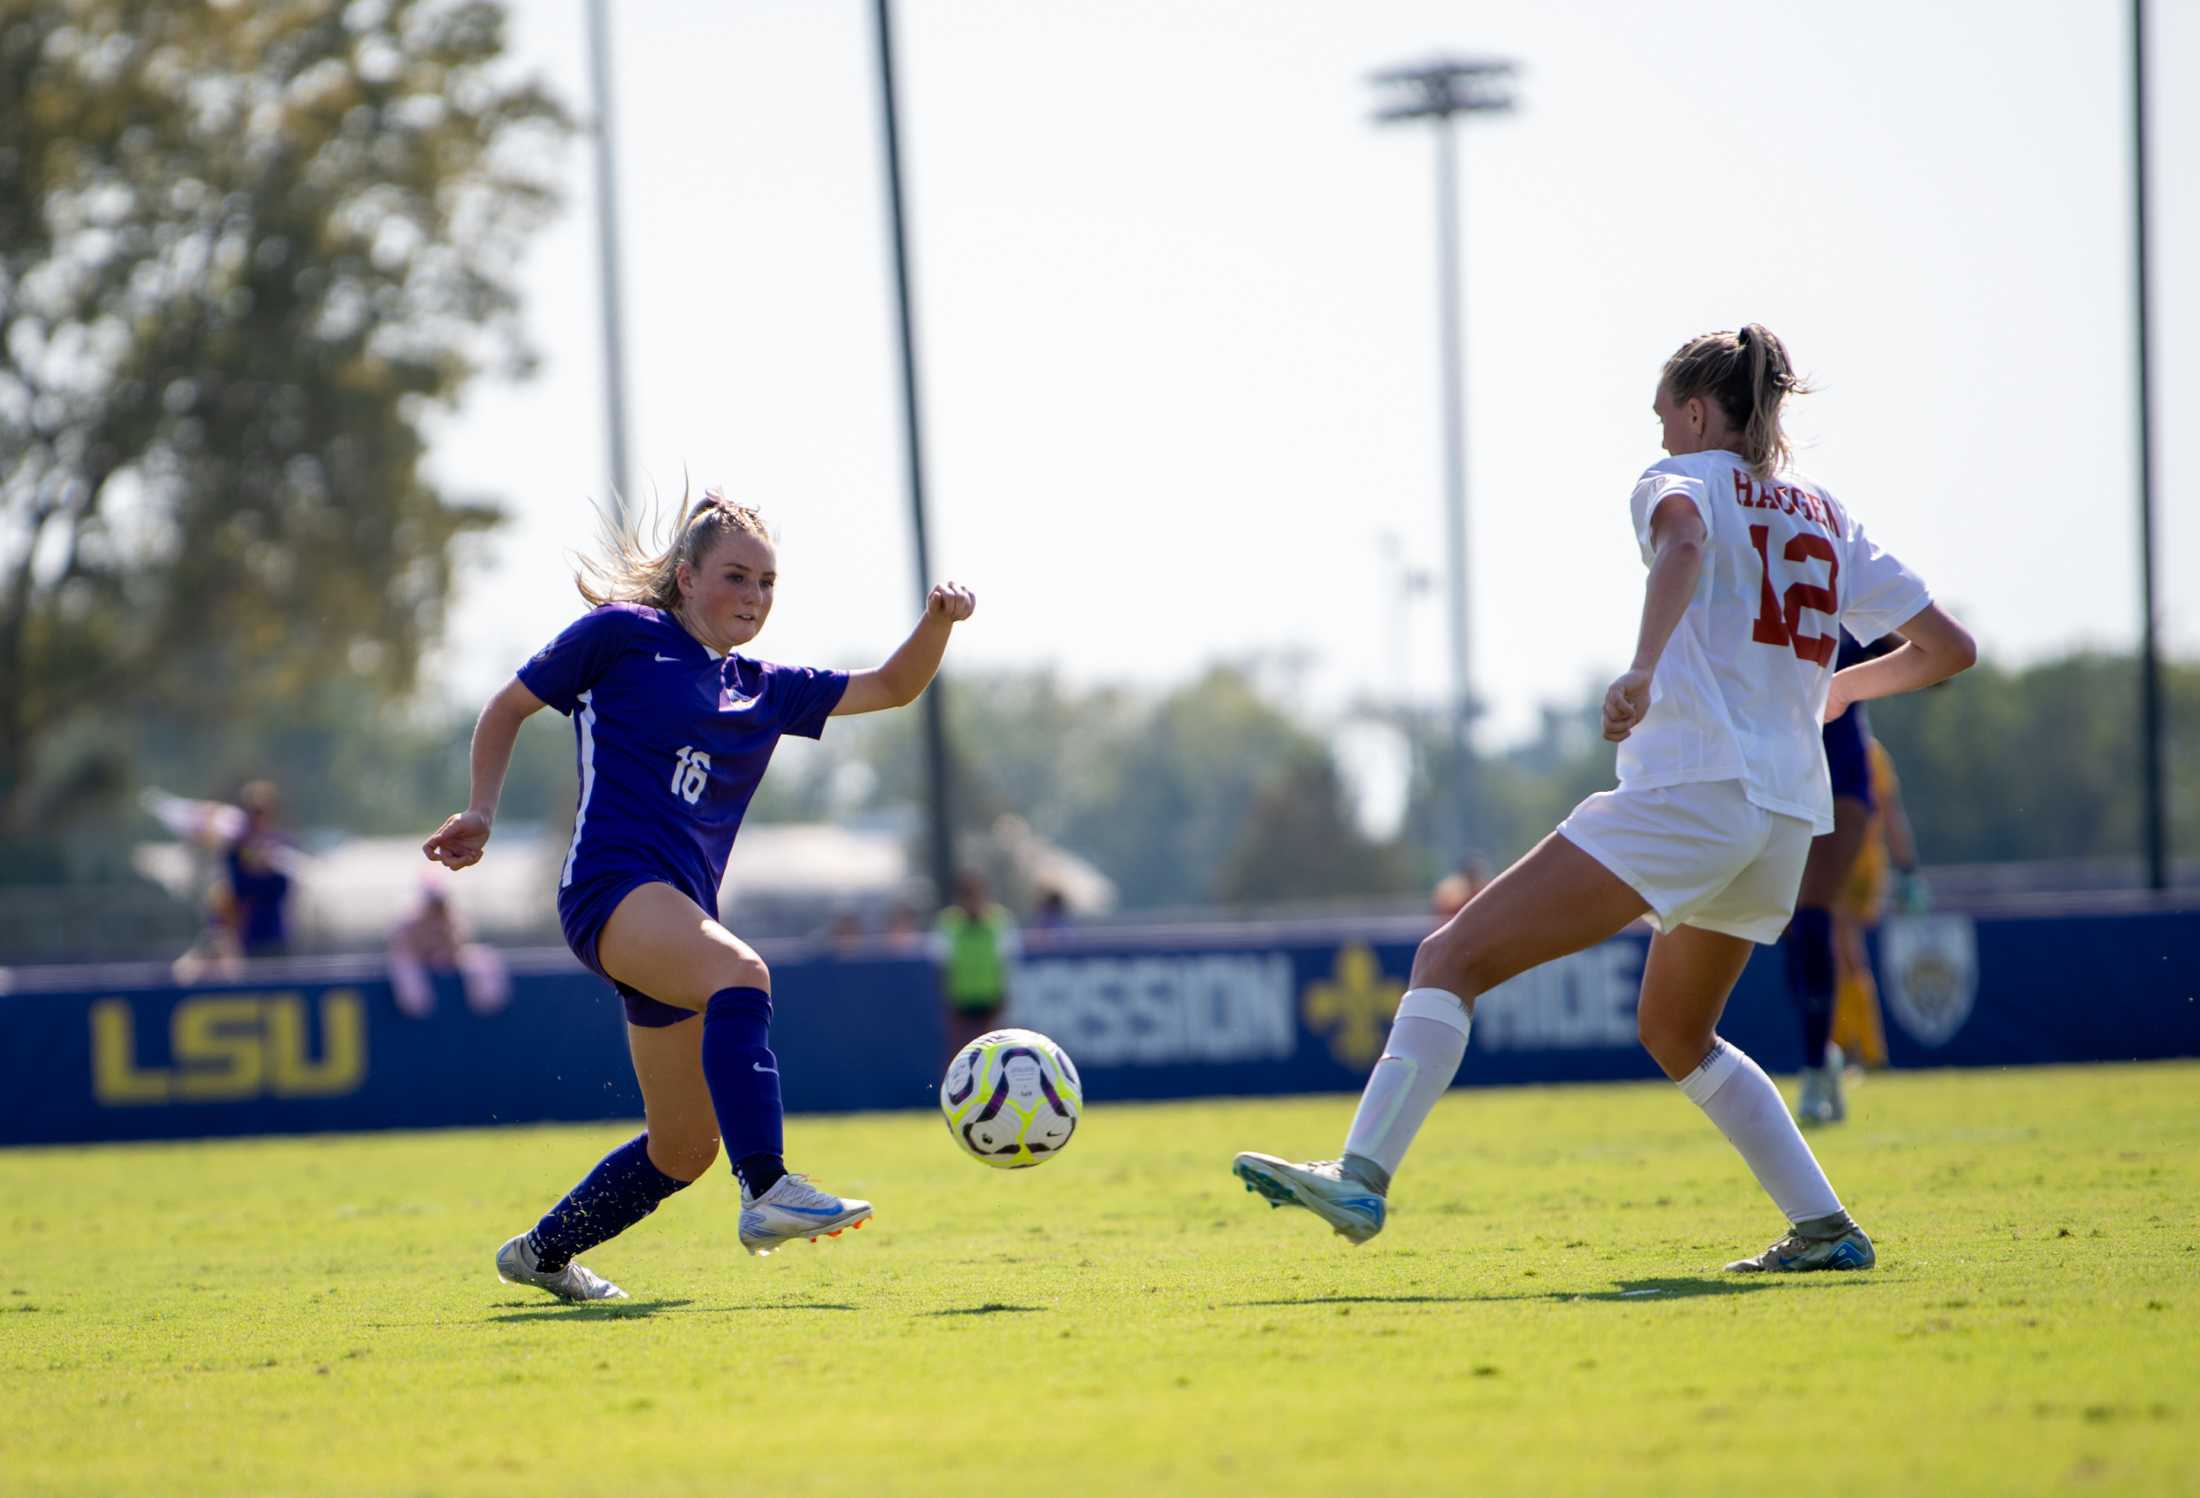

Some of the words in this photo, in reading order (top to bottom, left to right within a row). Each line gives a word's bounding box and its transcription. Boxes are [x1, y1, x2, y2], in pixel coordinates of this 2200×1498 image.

[1749, 525, 1840, 669] 12
[671, 745, 711, 805] 16
[91, 990, 366, 1106] LSU
